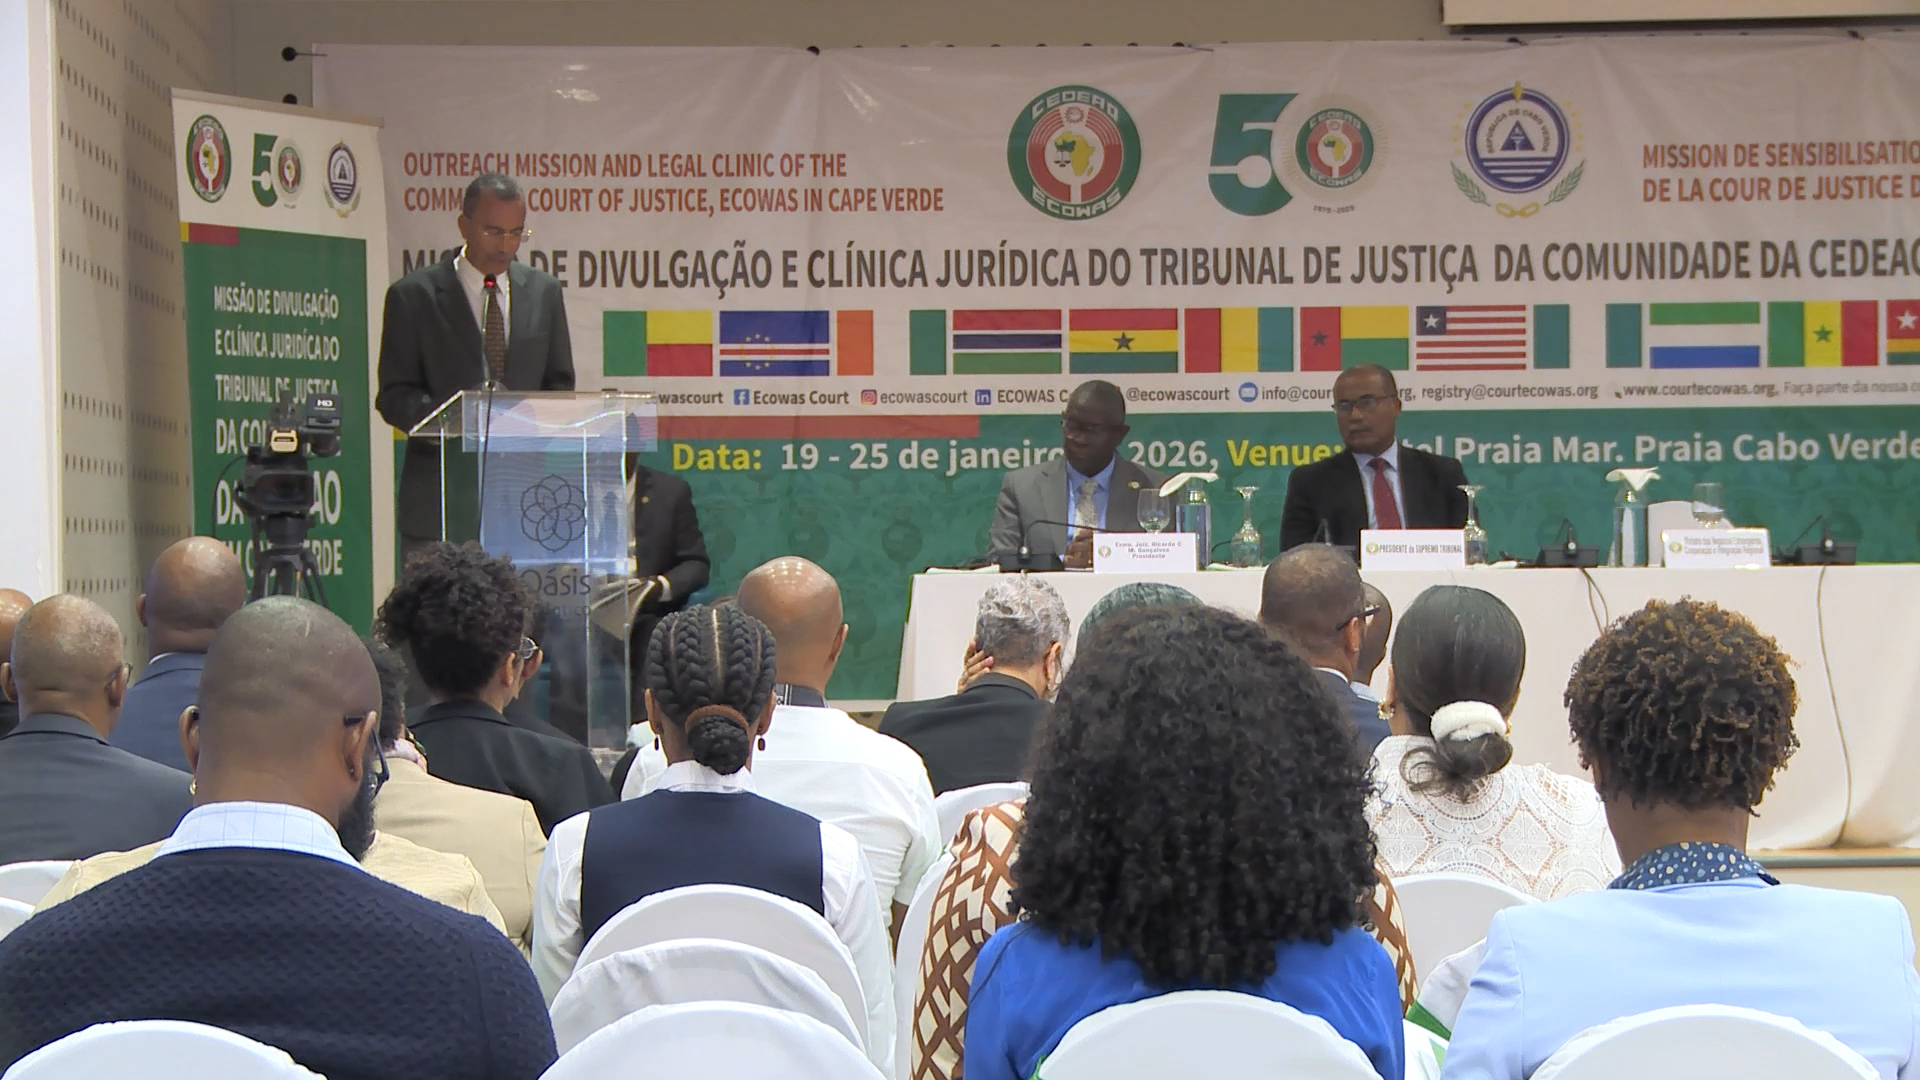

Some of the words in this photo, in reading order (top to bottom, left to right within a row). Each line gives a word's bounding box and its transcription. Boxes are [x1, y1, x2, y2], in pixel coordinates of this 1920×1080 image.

[1032, 91, 1119, 122] CEDEAO
[404, 152, 509, 177] OUTREACH
[516, 153, 597, 178] MISSION
[601, 153, 642, 178] AND
[647, 153, 707, 178] LEGAL
[712, 153, 775, 178] CLINIC
[779, 153, 805, 178] OF
[810, 153, 847, 178] THE
[1643, 143, 1727, 169] MISSION
[1734, 143, 1760, 168] DE
[527, 187, 594, 213] COURT
[598, 187, 623, 213] OF
[629, 187, 715, 218] JUSTICE,
[719, 187, 799, 213] ECOWAS
[803, 187, 822, 213] IN
[828, 187, 878, 213] CAPE
[881, 187, 945, 213] VERDE
[1032, 185, 1122, 218] ECOWAS
[1643, 178, 1671, 203] DE
[1678, 177, 1704, 202] LA
[1709, 177, 1771, 202] COUR
[1778, 176, 1806, 201] DE
[1812, 174, 1904, 201] JUSTICE
[578, 239, 773, 300] DIVULGAÇÃO
[782, 249, 799, 289] E
[807, 240, 929, 289] CLÍNICA
[935, 239, 1080, 288] JURÍDICA
[1088, 247, 1131, 287] DO
[1140, 246, 1294, 287] TRIBUNAL
[1303, 245, 1341, 284] DE
[1350, 244, 1479, 294] JUSTIÇA
[1494, 243, 1535, 283] DA
[1542, 240, 1751, 283] COMUNIDADE
[1760, 240, 1802, 279] DA
[213, 281, 255, 313] MISSÃO
[257, 289, 271, 315] DE
[273, 288, 340, 325] DIVULGAÇÃO
[215, 329, 222, 356] E
[223, 324, 268, 358] CLÍNICA
[323, 335, 340, 362] DO
[215, 374, 273, 403] TRIBUNAL
[753, 391, 805, 405] Ecowas
[809, 390, 849, 404] Court
[880, 389, 968, 404] ecowascourt
[997, 389, 1054, 403] ECOWAS
[1126, 387, 1230, 402] @ecowascourt
[1421, 384, 1599, 401] registry@courtecowas.org
[215, 418, 238, 454] DA
[672, 442, 762, 471] Data:
[781, 443, 819, 471] 19
[849, 442, 888, 470] 25
[898, 440, 939, 470] de
[1127, 440, 1219, 474] 2026,
[1454, 433, 1542, 464] Praia
[1553, 435, 1624, 464] Mar.
[1635, 432, 1723, 462] Praia
[1733, 431, 1820, 462] Cabo
[1379, 544, 1408, 554] PRESIDENTE
[1415, 544, 1439, 554] SUPREMO
[1439, 544, 1463, 554] TRIBUNAL
[520, 568, 592, 596] Oásis
